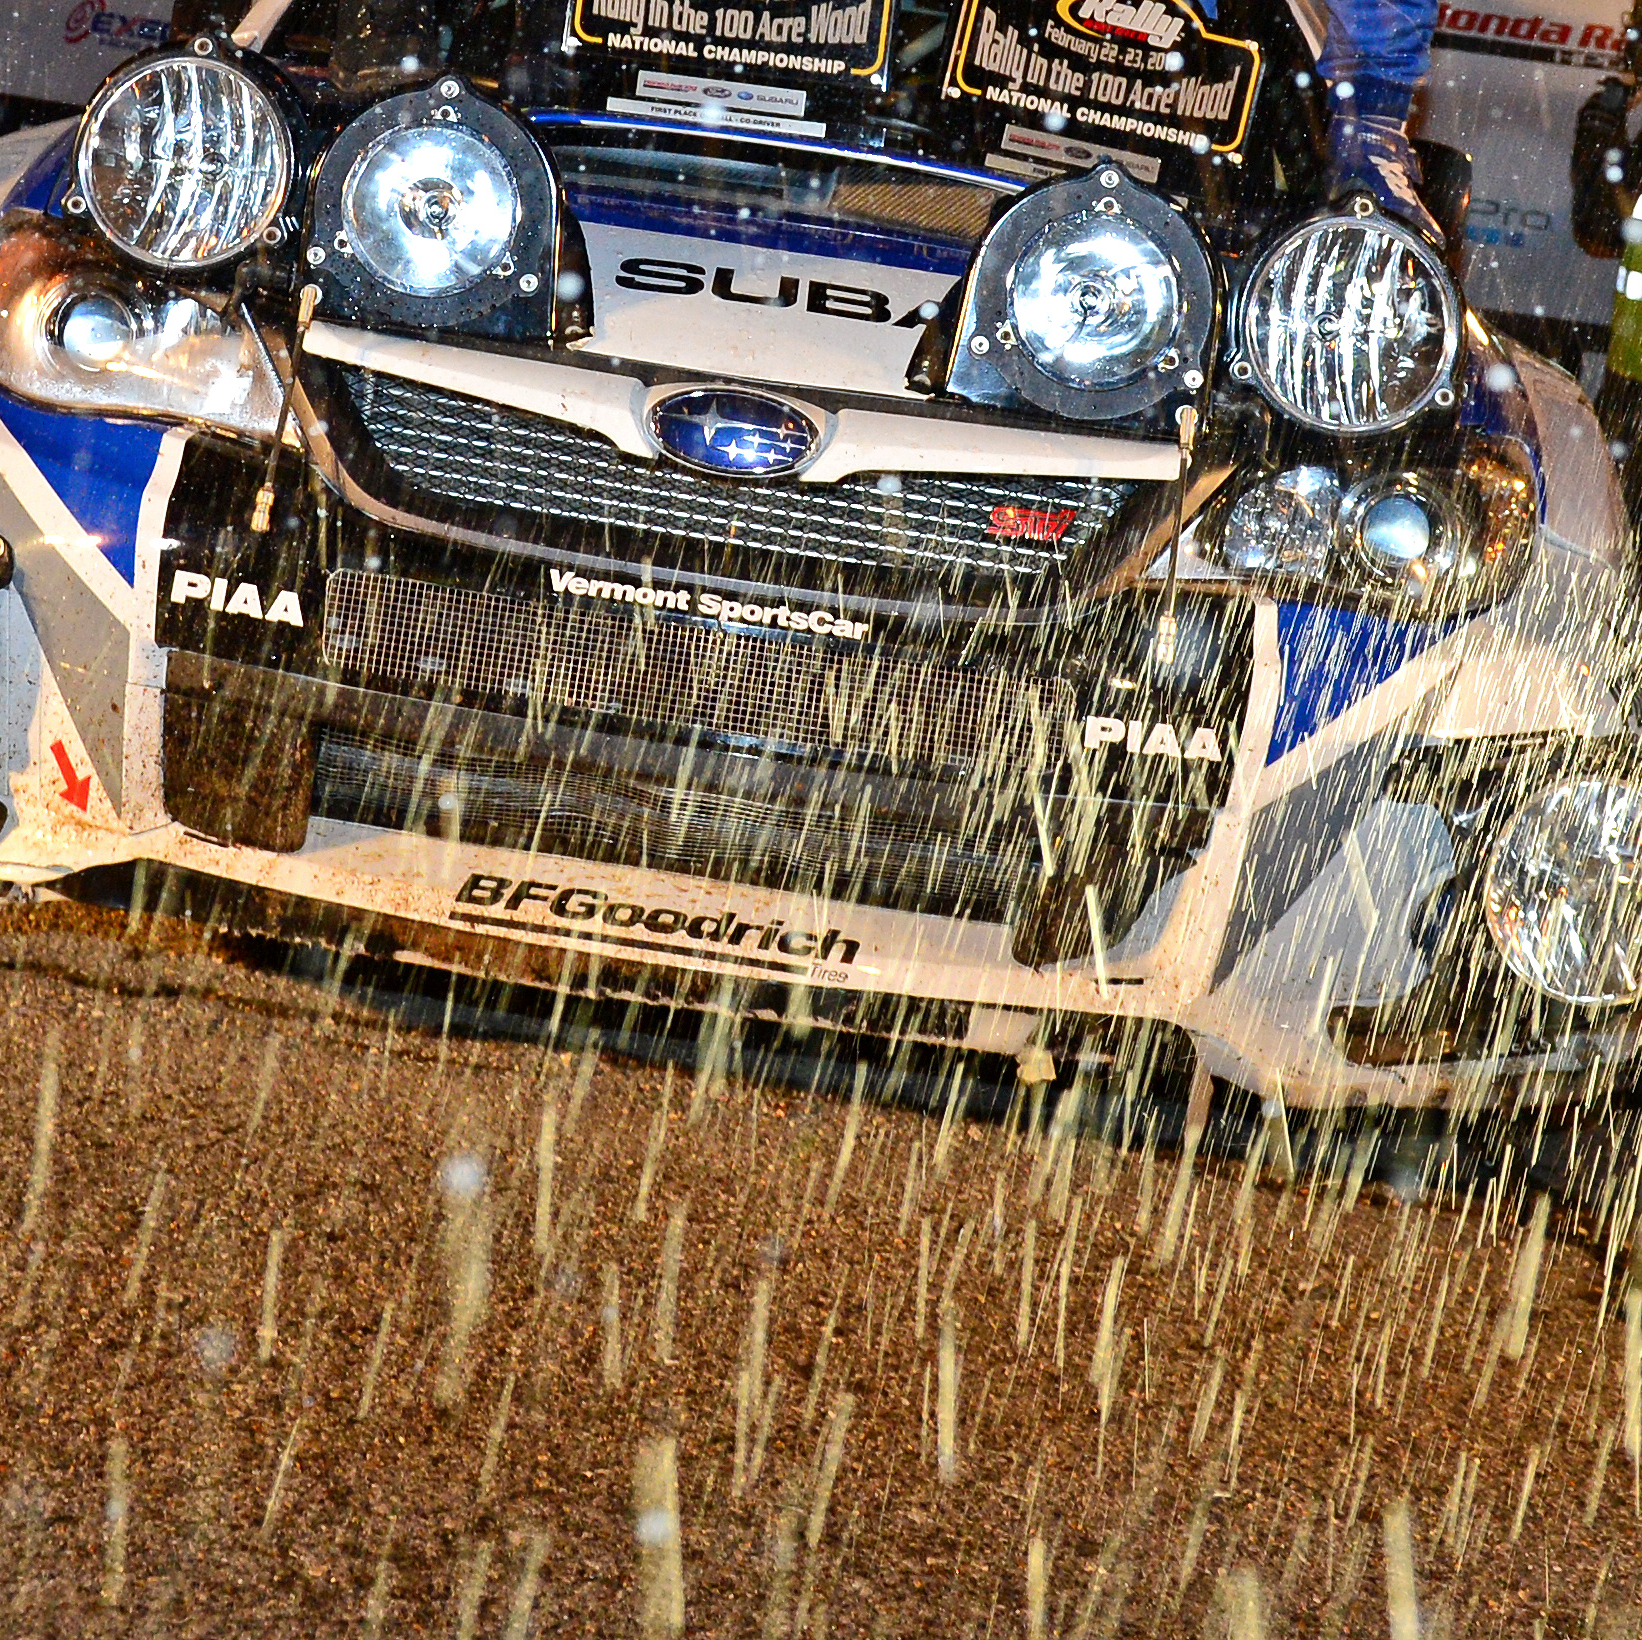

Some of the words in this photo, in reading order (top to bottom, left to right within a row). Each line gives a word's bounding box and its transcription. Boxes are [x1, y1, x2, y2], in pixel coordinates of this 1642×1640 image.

[714, 9, 754, 42] 100
[755, 9, 806, 44] Acre
[1044, 18, 1100, 63] February
[607, 33, 698, 58] NATIONAL
[703, 40, 847, 75] CHAMPIONSHIP
[973, 6, 1031, 90] Rally
[1027, 42, 1048, 87] in
[1051, 55, 1085, 97] the
[1089, 71, 1127, 107] 100
[1126, 78, 1176, 113] Acre
[1176, 65, 1241, 121] Wood
[985, 84, 1072, 119] NATIONAL
[1075, 106, 1209, 148] CHAMPIONSHIP
[170, 569, 306, 628] PIAA
[549, 568, 691, 611] Vermont
[696, 592, 871, 641] SportsCar
[1083, 714, 1223, 763] PIAA
[453, 872, 862, 966] BFGoodrich
[810, 961, 851, 984] Tires
